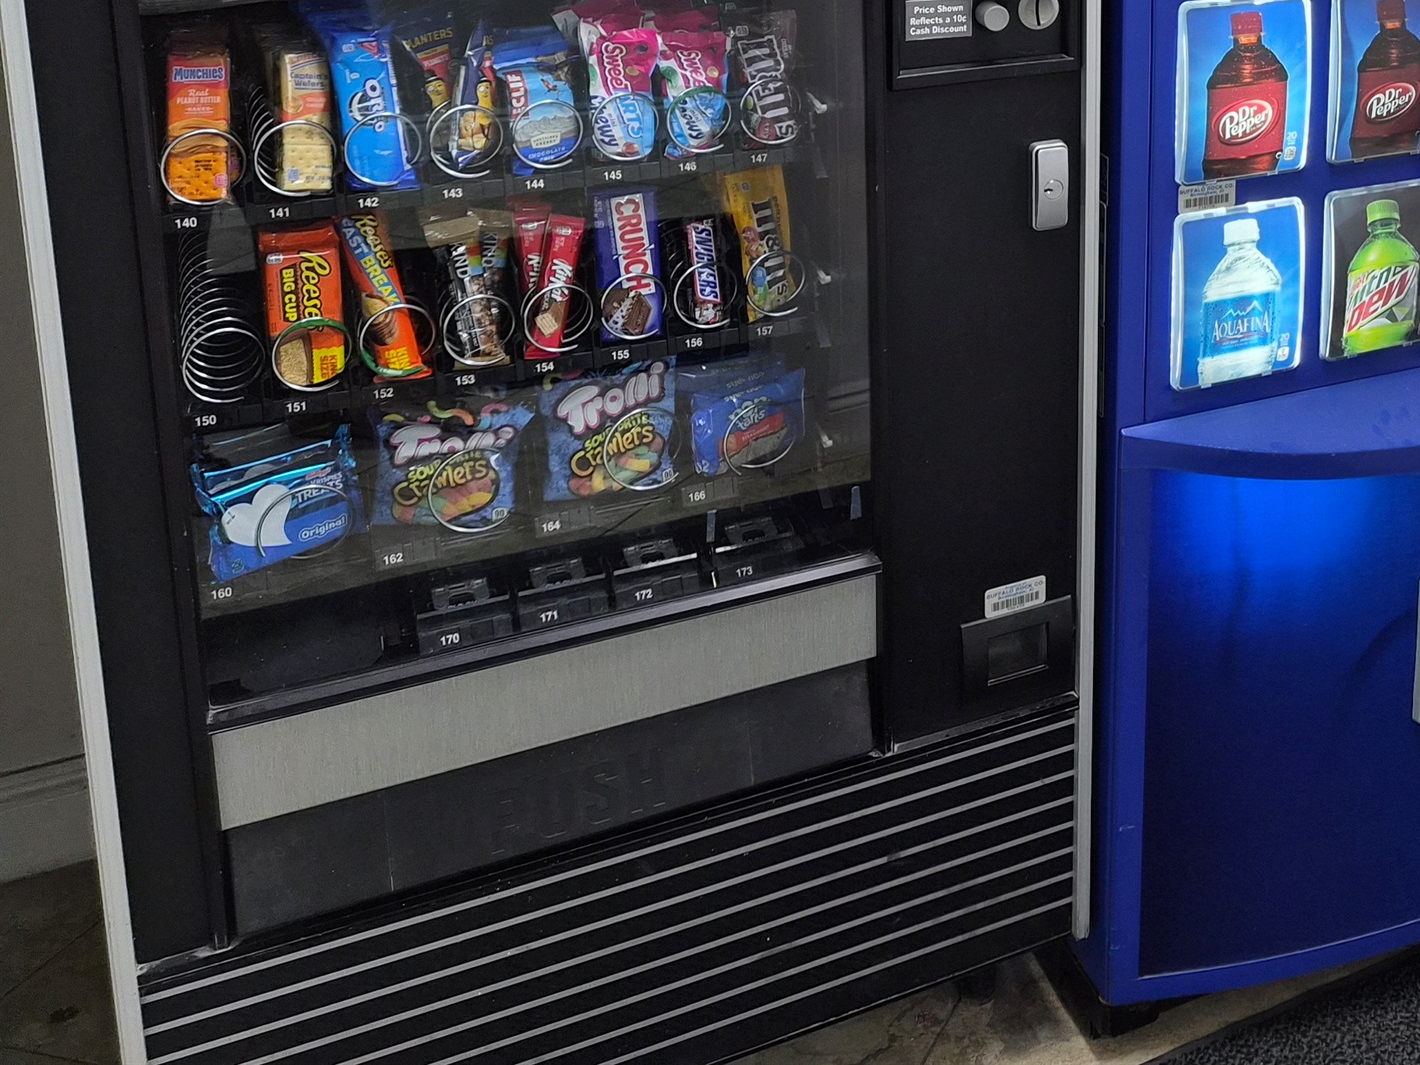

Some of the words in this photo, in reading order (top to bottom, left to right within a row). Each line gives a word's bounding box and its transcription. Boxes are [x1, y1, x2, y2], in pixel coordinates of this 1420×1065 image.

[914, 6, 934, 14] Price
[937, 5, 964, 13] Shown
[910, 17, 943, 26] Reflects
[910, 27, 930, 35] Cash
[932, 25, 967, 34] Discount
[405, 27, 453, 49] PLANTERS
[508, 75, 525, 107] CLIF
[1384, 87, 1403, 102] Dr
[177, 96, 199, 104] PEANUT
[1367, 91, 1413, 119] Pepper
[1238, 105, 1257, 119] Dr
[1220, 109, 1270, 139] Pepper
[751, 153, 768, 163] 147
[679, 162, 697, 172] 146
[604, 170, 622, 180] 145
[525, 179, 544, 190] 144
[442, 188, 463, 199] 143
[358, 197, 379, 208] 142
[269, 207, 290, 219] 141
[175, 217, 197, 228] 140
[482, 232, 498, 267] KIND
[614, 197, 652, 293] CRUNCH
[450, 243, 470, 279] KIND
[692, 225, 718, 300] SNICKERS
[282, 268, 295, 293] BIG
[284, 295, 298, 322] CUP
[756, 326, 773, 336] 157
[1211, 310, 1270, 343] AQUAFINA
[685, 338, 702, 347] 156
[611, 349, 629, 360] 155
[535, 362, 554, 372] 154
[455, 375, 475, 385] 153
[373, 388, 393, 399] 152
[557, 361, 666, 435] Trolli
[286, 401, 307, 413] 151
[195, 415, 217, 426] 150
[571, 426, 654, 476] Crawlers
[688, 490, 706, 502] 166
[299, 514, 346, 541] Original
[542, 519, 561, 532] 164
[383, 553, 403, 565] 162
[735, 566, 753, 577] 173
[211, 587, 232, 599] 160
[1015, 583, 1032, 591] ROCK
[634, 588, 653, 601] 172
[540, 610, 559, 622] 171
[440, 633, 460, 645] 170
